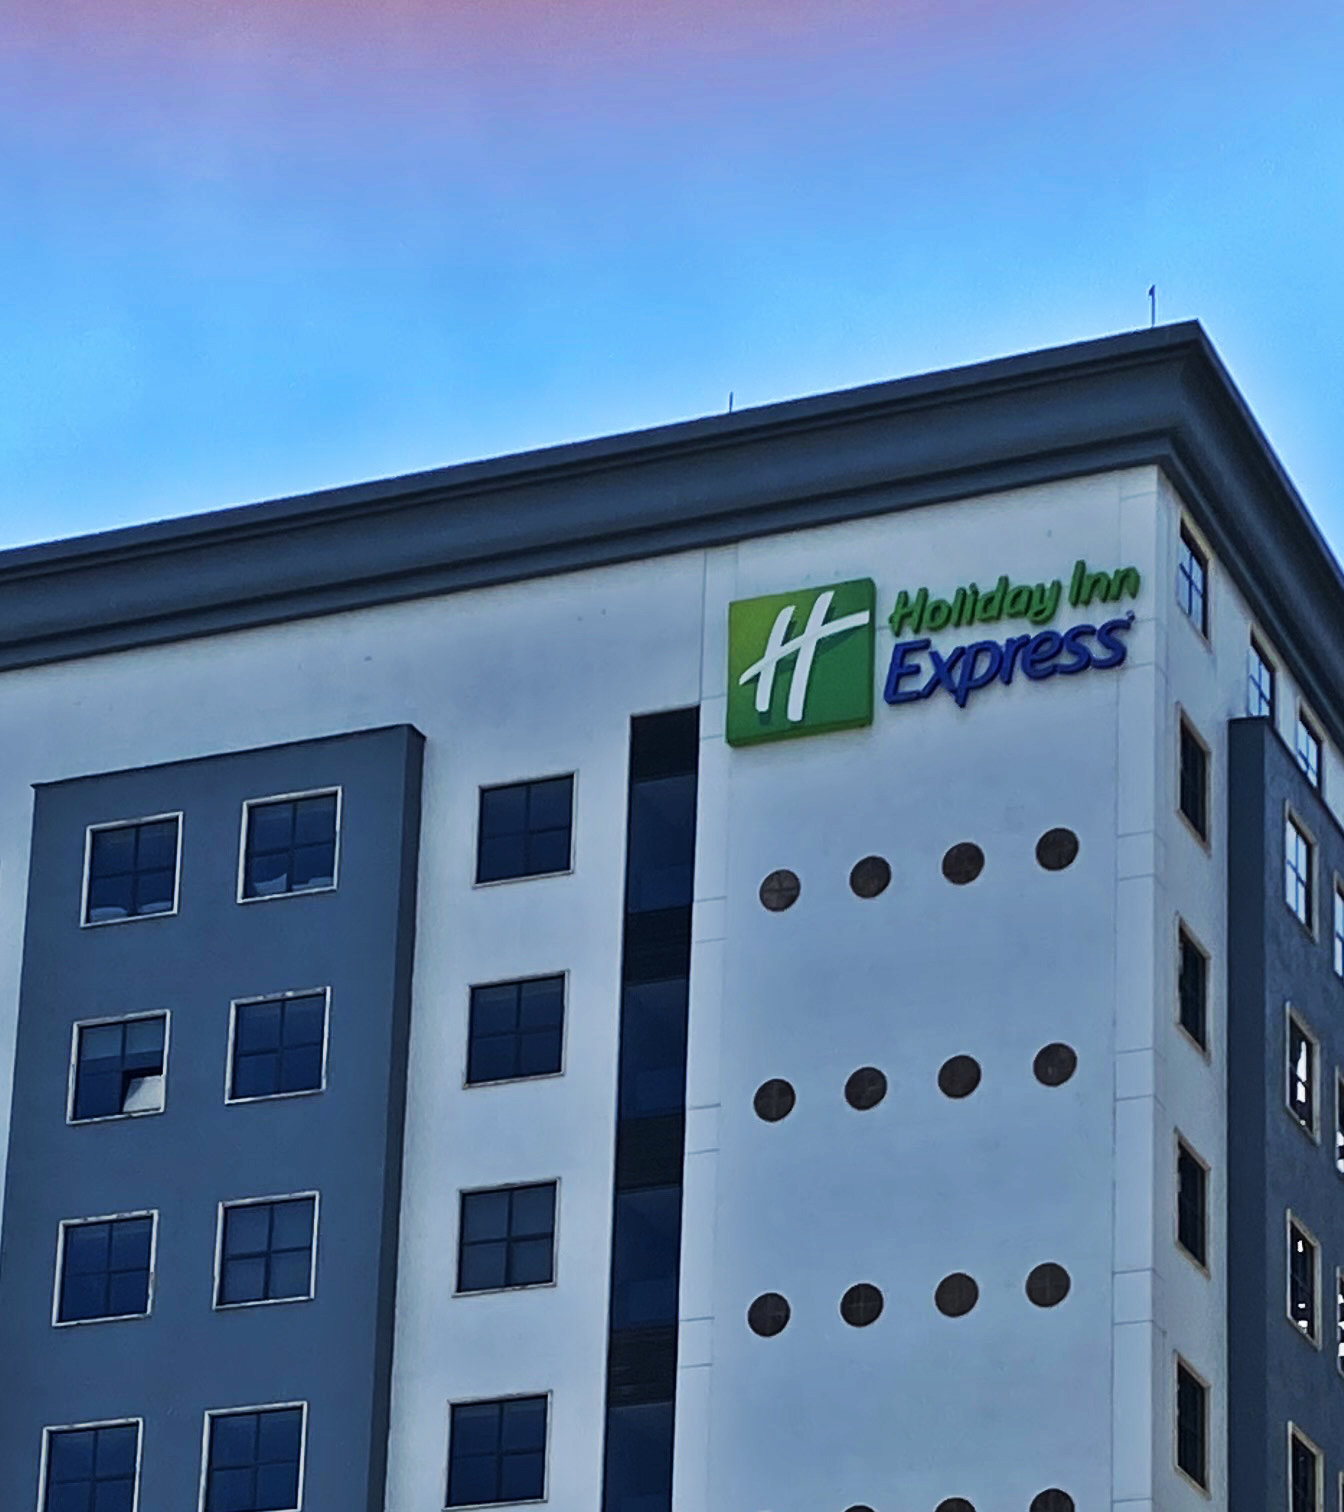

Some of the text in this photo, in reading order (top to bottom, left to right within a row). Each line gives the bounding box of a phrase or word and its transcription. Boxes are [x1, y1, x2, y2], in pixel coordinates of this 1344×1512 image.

[888, 559, 1141, 637] Holiday Inn
[882, 617, 1130, 708] Express
